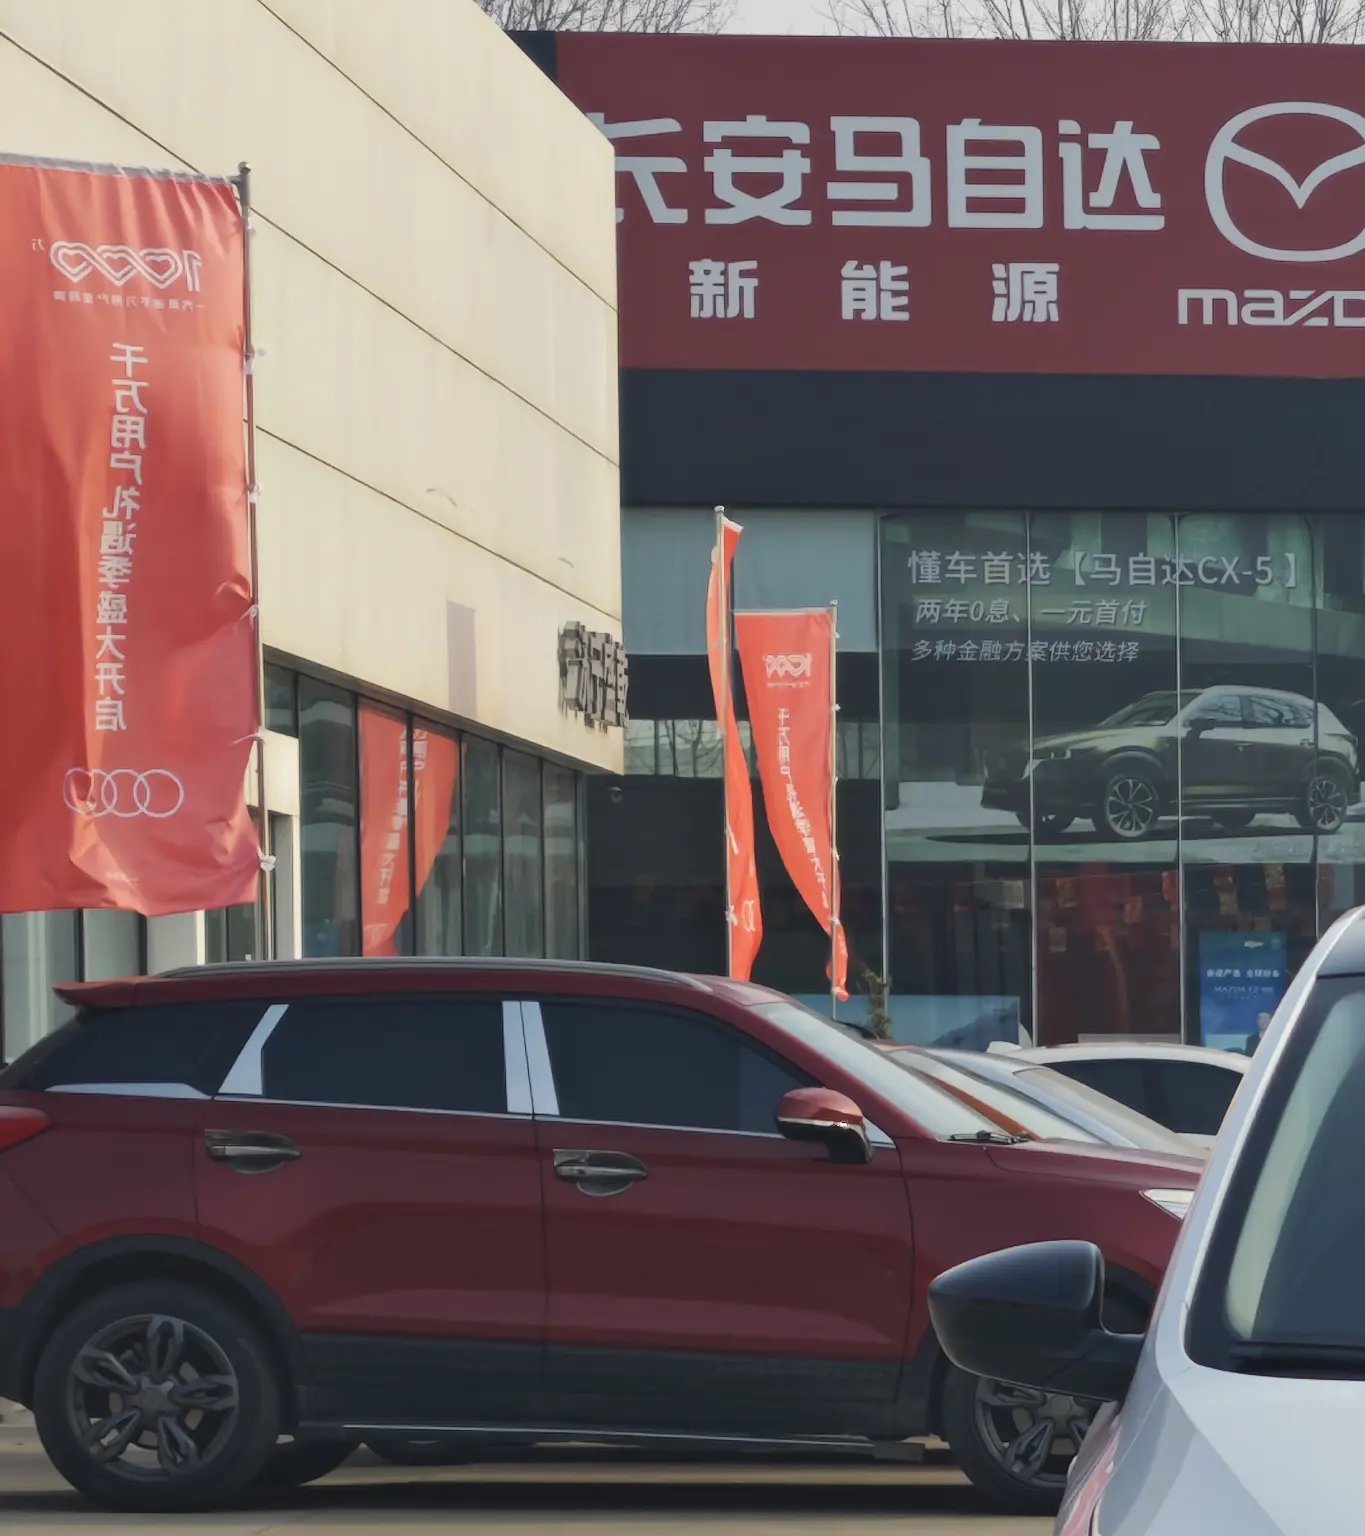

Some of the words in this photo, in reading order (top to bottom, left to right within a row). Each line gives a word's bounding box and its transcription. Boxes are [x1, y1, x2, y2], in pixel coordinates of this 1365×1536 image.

[910, 639, 1141, 664] 多种金融方案供您选择
